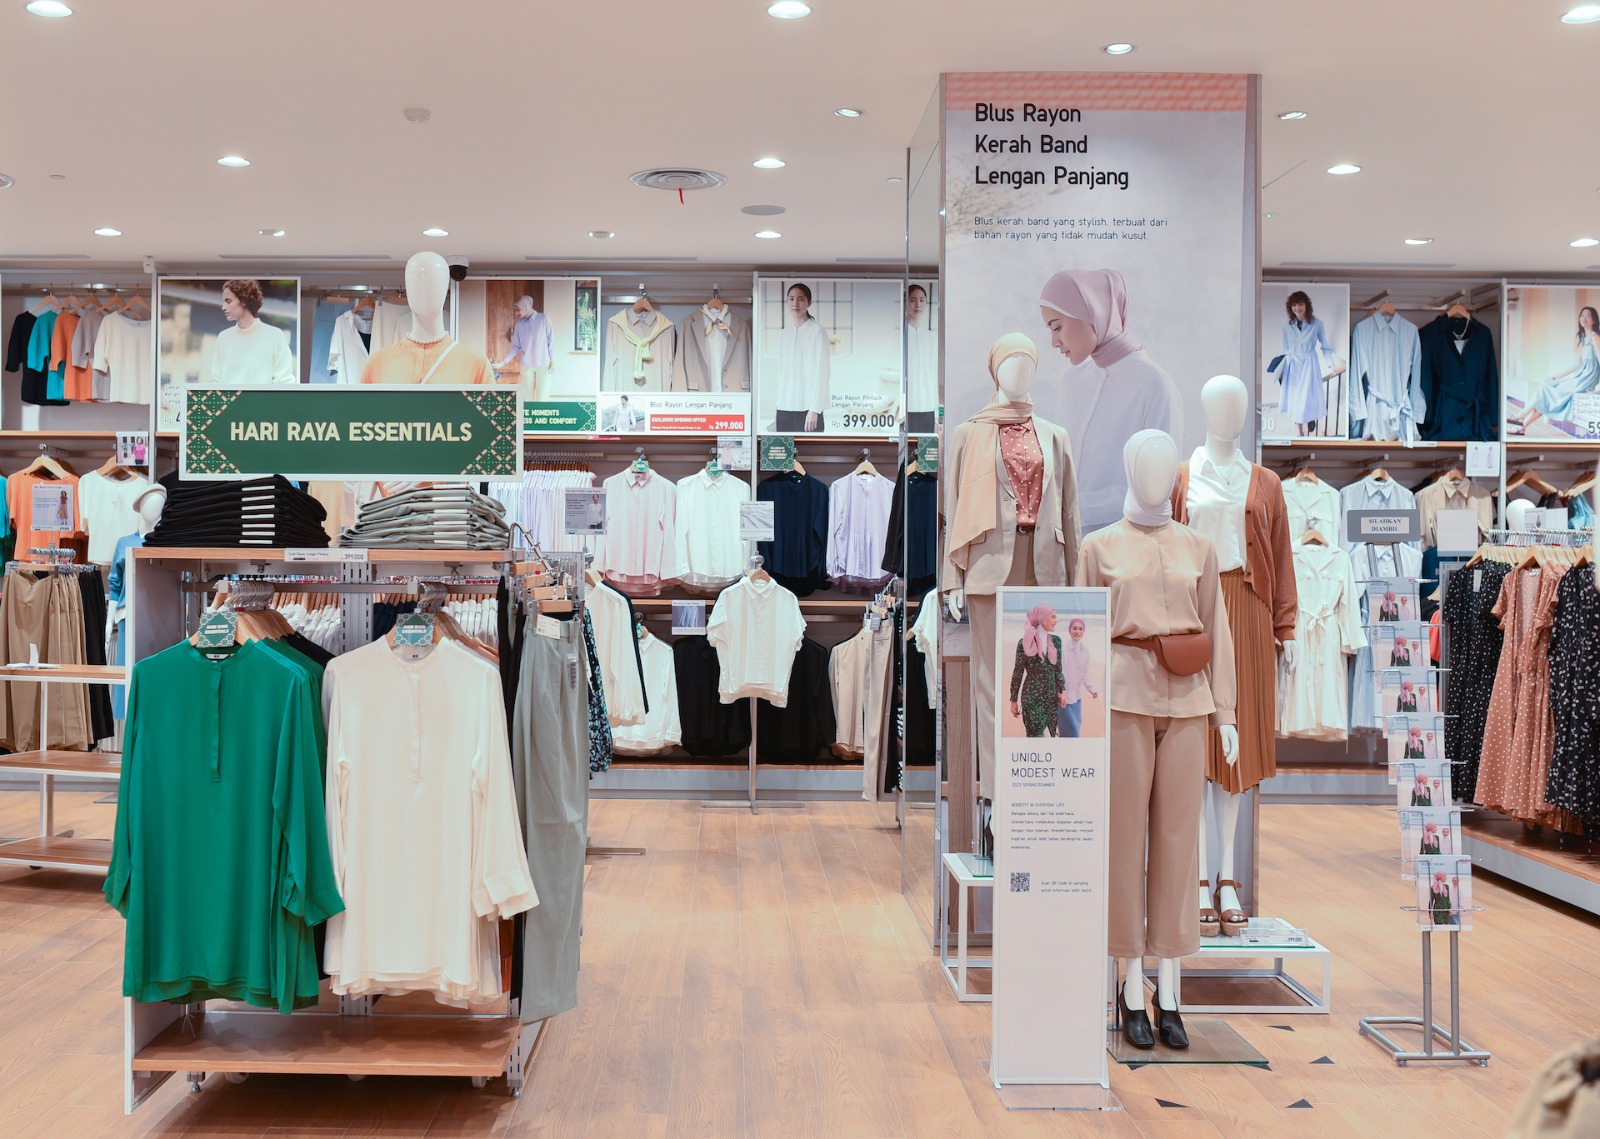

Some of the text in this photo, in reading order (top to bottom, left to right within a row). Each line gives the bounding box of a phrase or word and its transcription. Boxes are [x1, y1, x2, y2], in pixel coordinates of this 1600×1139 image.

[975, 102, 1081, 127] Blus Rayon
[975, 134, 1088, 154] Kerah Band
[975, 166, 1129, 190] Lengan Panjang
[974, 216, 994, 226] Blus
[997, 216, 1024, 226] kerah
[1027, 216, 1050, 226] band
[1053, 218, 1075, 228] yang
[1112, 218, 1146, 226] terbuat
[1150, 218, 1168, 226] dari
[974, 230, 1002, 240] bahan
[1006, 232, 1032, 241] rayon
[1036, 232, 1058, 242] yang
[1061, 231, 1084, 240] tidak
[1087, 231, 1118, 240] mudah
[715, 421, 744, 430] 299.000
[843, 414, 894, 428] 399.000
[230, 422, 473, 442] HARI RAYA ESSENTIALS
[1011, 752, 1052, 764] UNIQLO
[1011, 767, 1095, 778] MODEST WEAR
